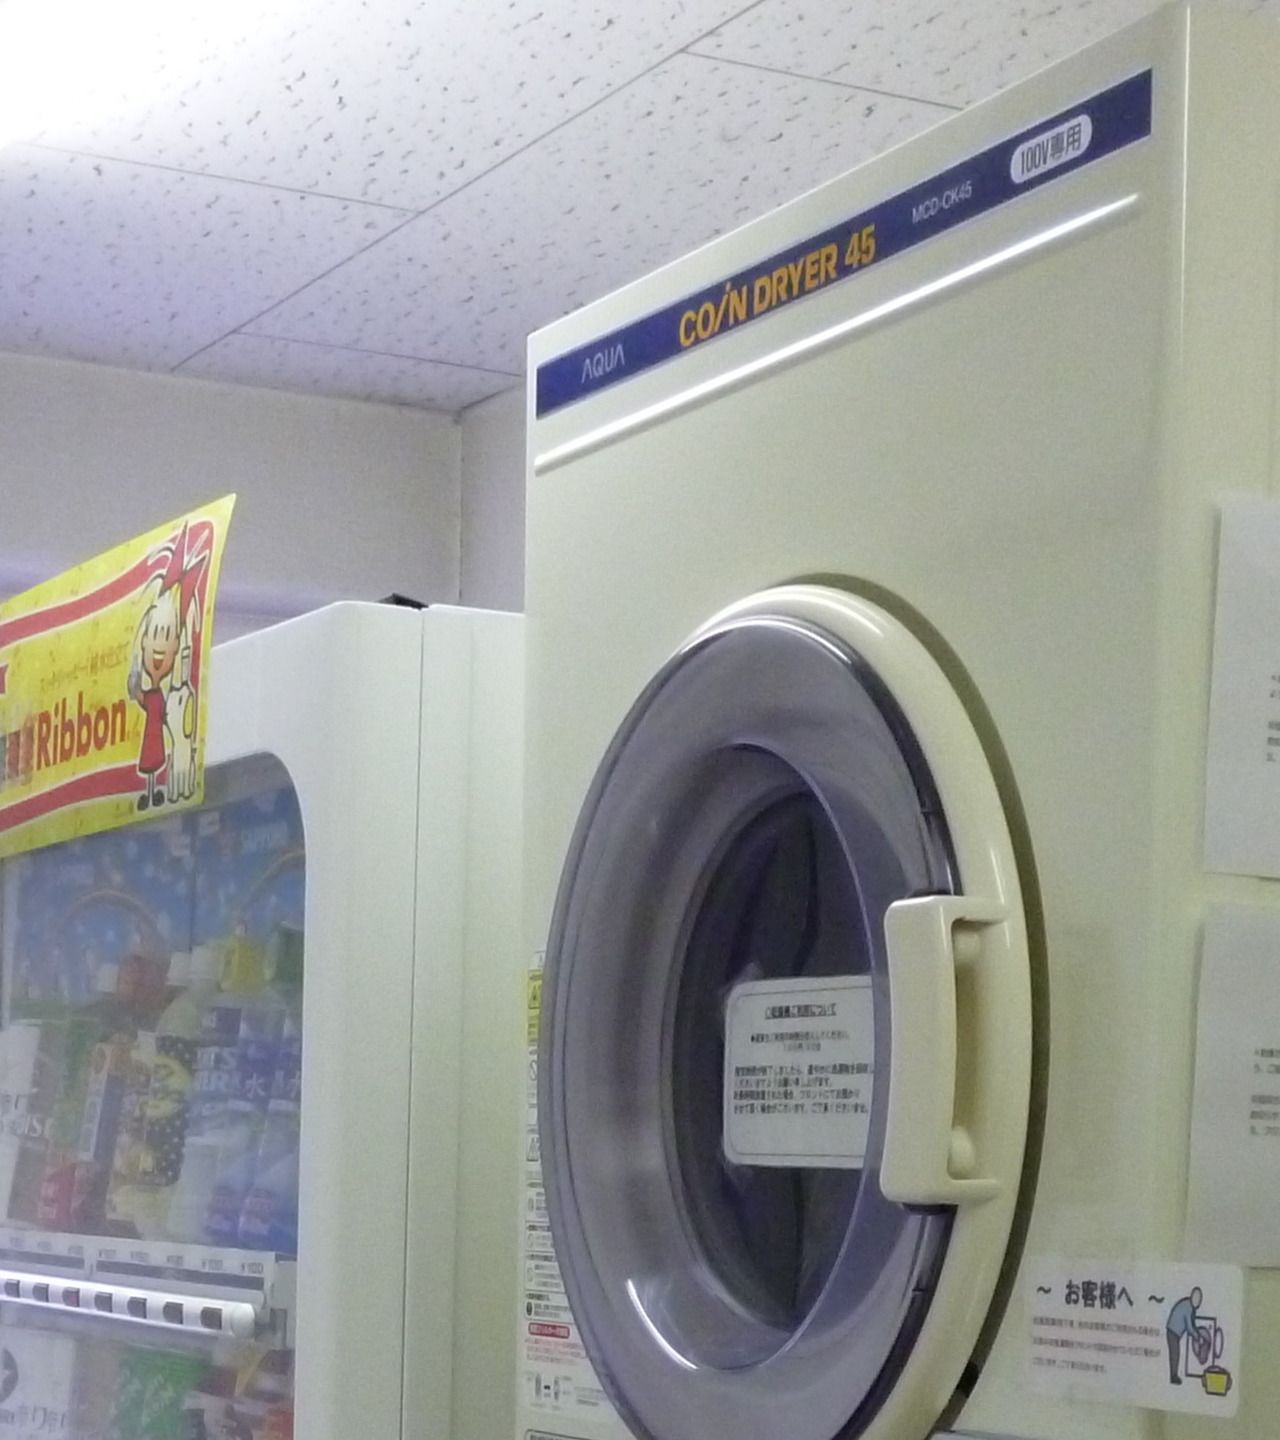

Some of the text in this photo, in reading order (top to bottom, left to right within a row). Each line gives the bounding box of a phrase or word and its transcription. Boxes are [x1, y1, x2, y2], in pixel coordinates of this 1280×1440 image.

[1018, 121, 1082, 176] 100V専用
[911, 180, 973, 225] MCD-CK45
[679, 224, 877, 348] COIN DRYER 45
[35, 691, 127, 770] Ribbon
[1064, 1280, 1134, 1309] お客様へ
